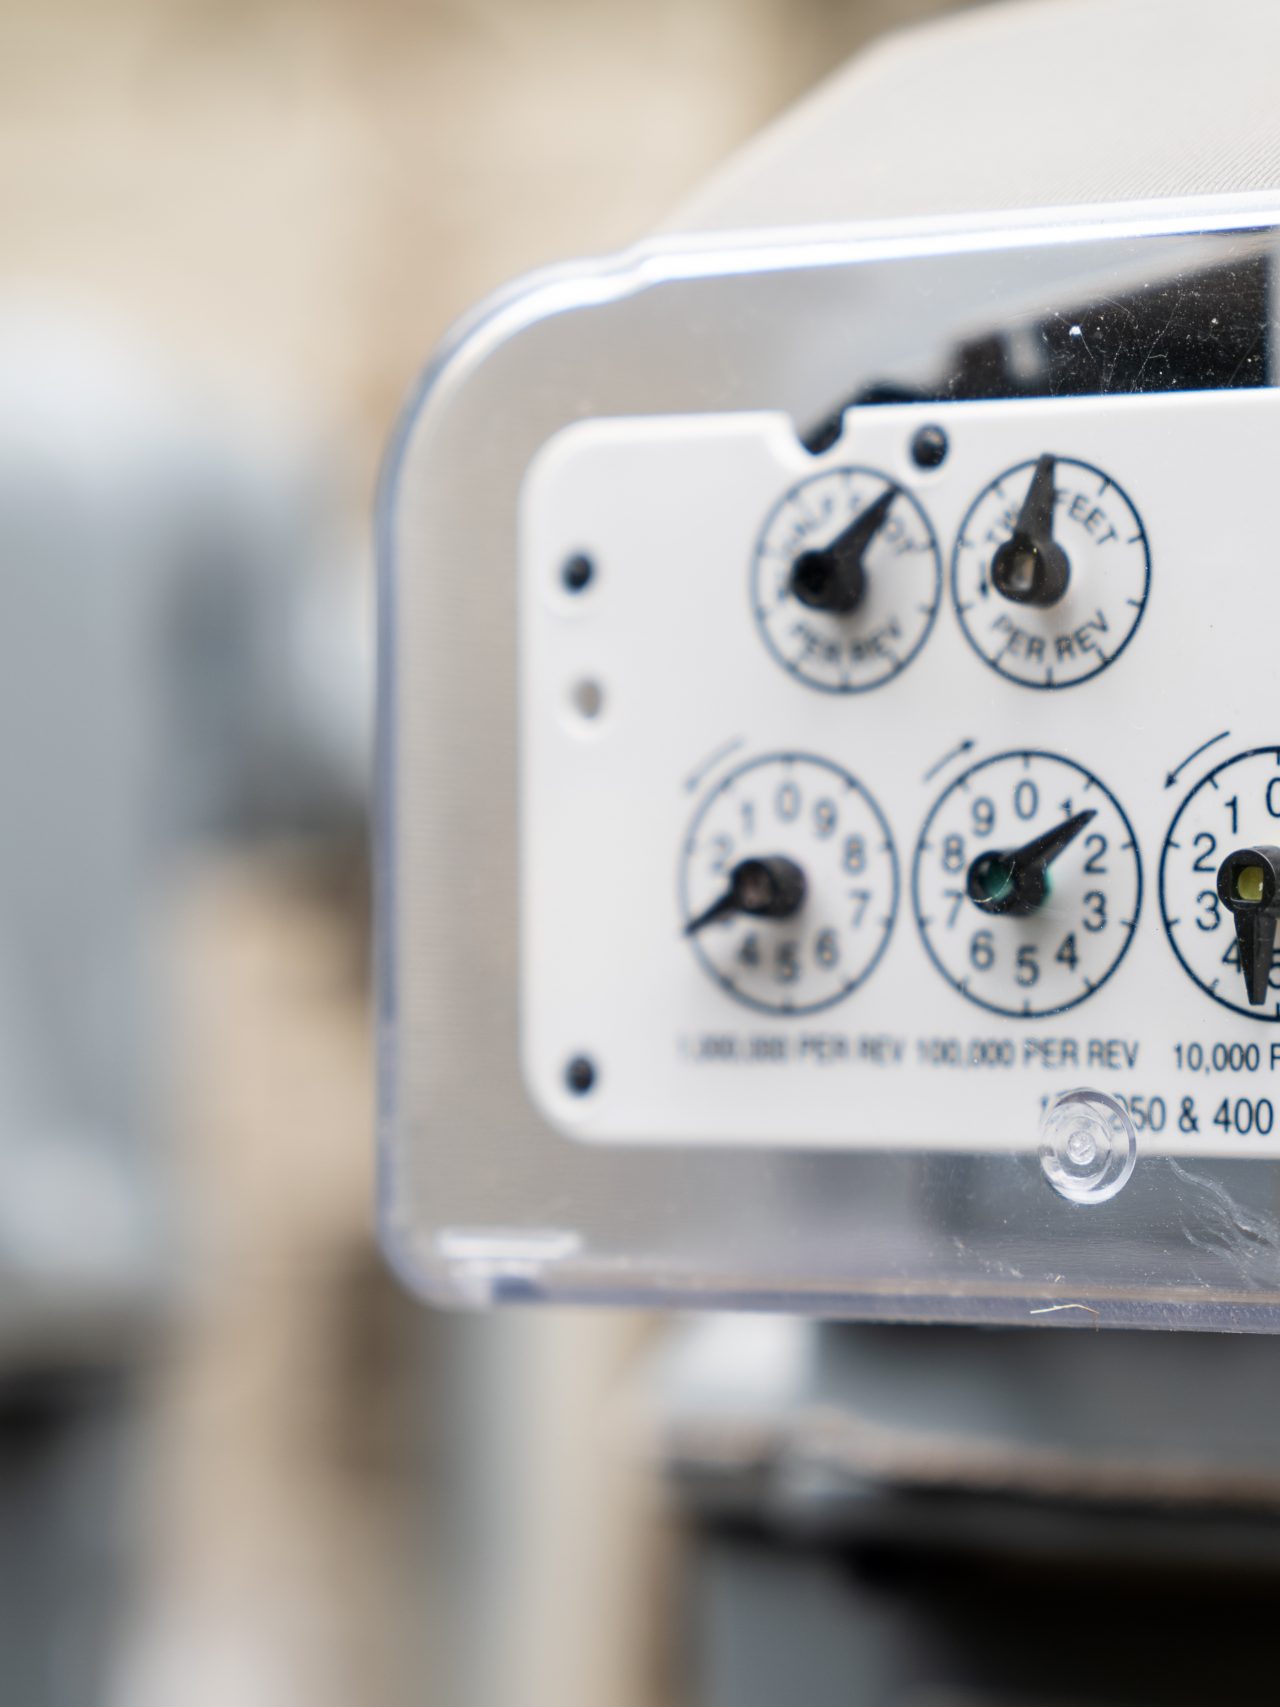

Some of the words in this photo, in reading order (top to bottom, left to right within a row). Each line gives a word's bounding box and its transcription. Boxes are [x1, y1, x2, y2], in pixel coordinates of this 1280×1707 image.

[991, 613, 1046, 663] PER
[1054, 608, 1110, 662] REV
[972, 797, 996, 837] 9
[1014, 779, 1039, 819] 0
[1224, 795, 1239, 834] 1
[942, 834, 965, 873] 8
[1084, 833, 1107, 873] 2
[1192, 833, 1217, 873] 2
[944, 891, 964, 929] 7
[1083, 891, 1107, 932] 3
[1195, 890, 1222, 932] 3
[971, 931, 995, 970] 6
[1014, 945, 1039, 987] 5
[1055, 932, 1079, 971] 4
[1222, 937, 1242, 974] 4
[917, 1038, 1015, 1068] 100,000
[1023, 1038, 1079, 1068] PER
[1088, 1039, 1140, 1069] REV
[1174, 1043, 1260, 1076] 10,000
[1178, 1095, 1200, 1134] &
[1213, 1097, 1275, 1136] 400
